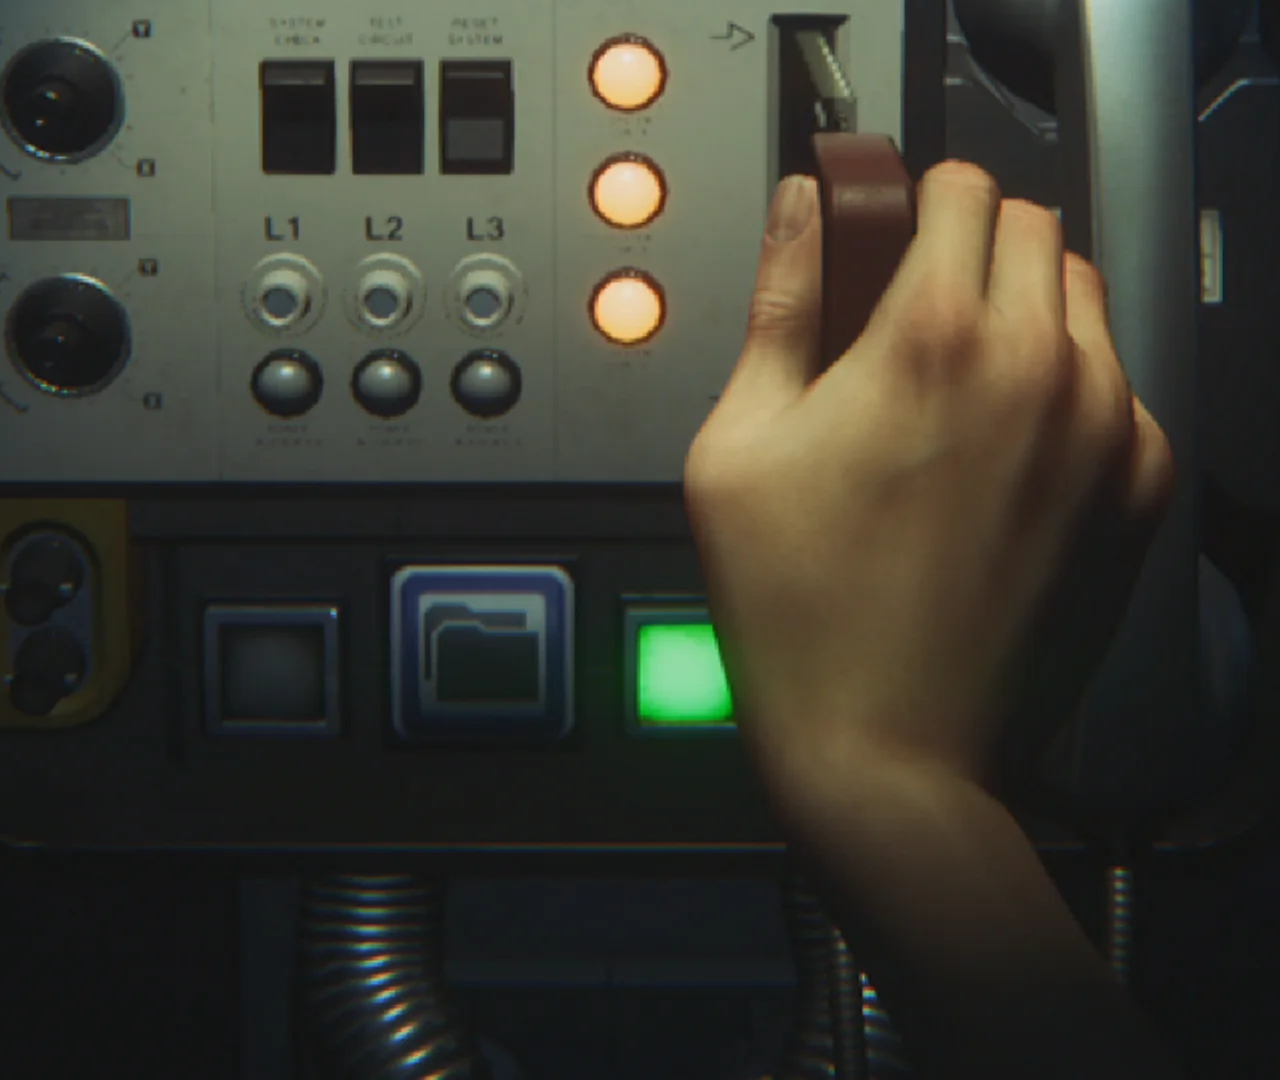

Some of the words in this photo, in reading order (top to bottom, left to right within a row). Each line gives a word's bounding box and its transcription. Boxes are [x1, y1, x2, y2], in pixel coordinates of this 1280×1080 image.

[265, 216, 301, 241] L1
[365, 216, 404, 241] L2
[466, 216, 506, 241] L3
